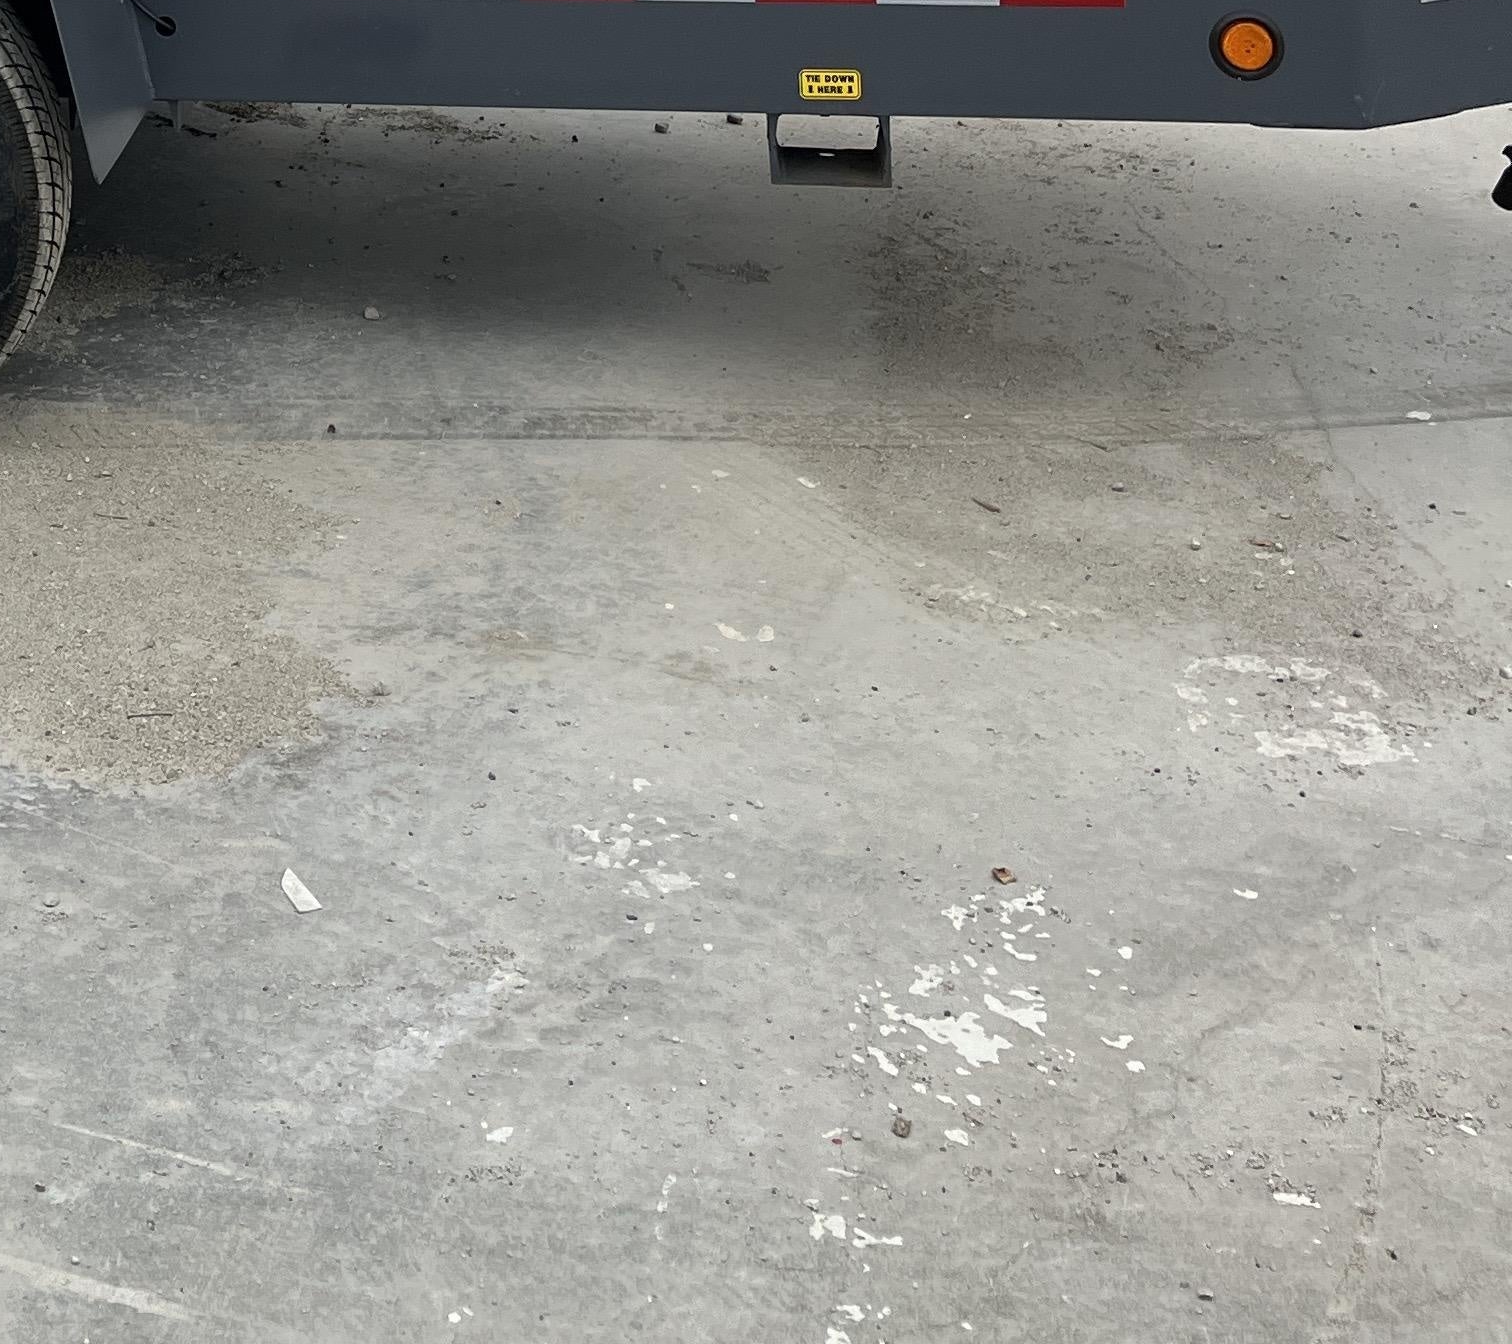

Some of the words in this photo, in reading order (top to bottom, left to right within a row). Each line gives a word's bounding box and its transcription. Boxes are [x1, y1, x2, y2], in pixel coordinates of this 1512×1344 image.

[805, 74, 820, 83] TIE
[824, 74, 854, 83] DOWN
[817, 85, 844, 94] HERE
